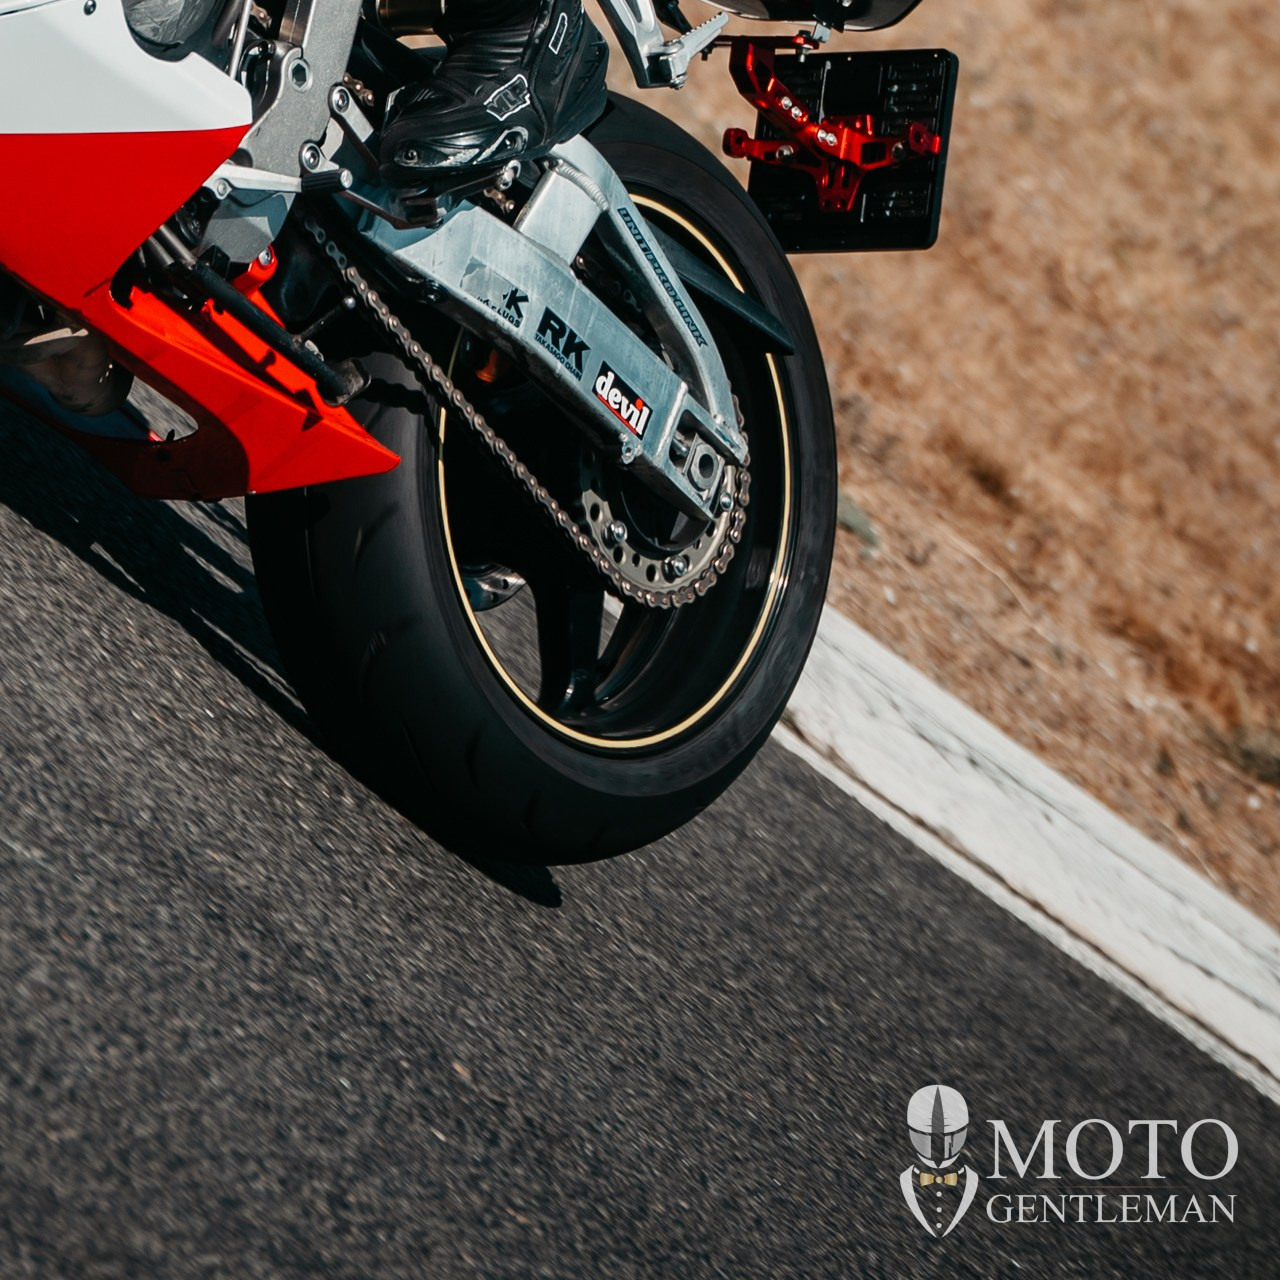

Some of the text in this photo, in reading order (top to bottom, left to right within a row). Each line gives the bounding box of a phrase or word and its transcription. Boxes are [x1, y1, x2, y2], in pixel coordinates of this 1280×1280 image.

[617, 207, 651, 253] UNIT
[536, 306, 592, 372] RK
[595, 371, 650, 435] devil
